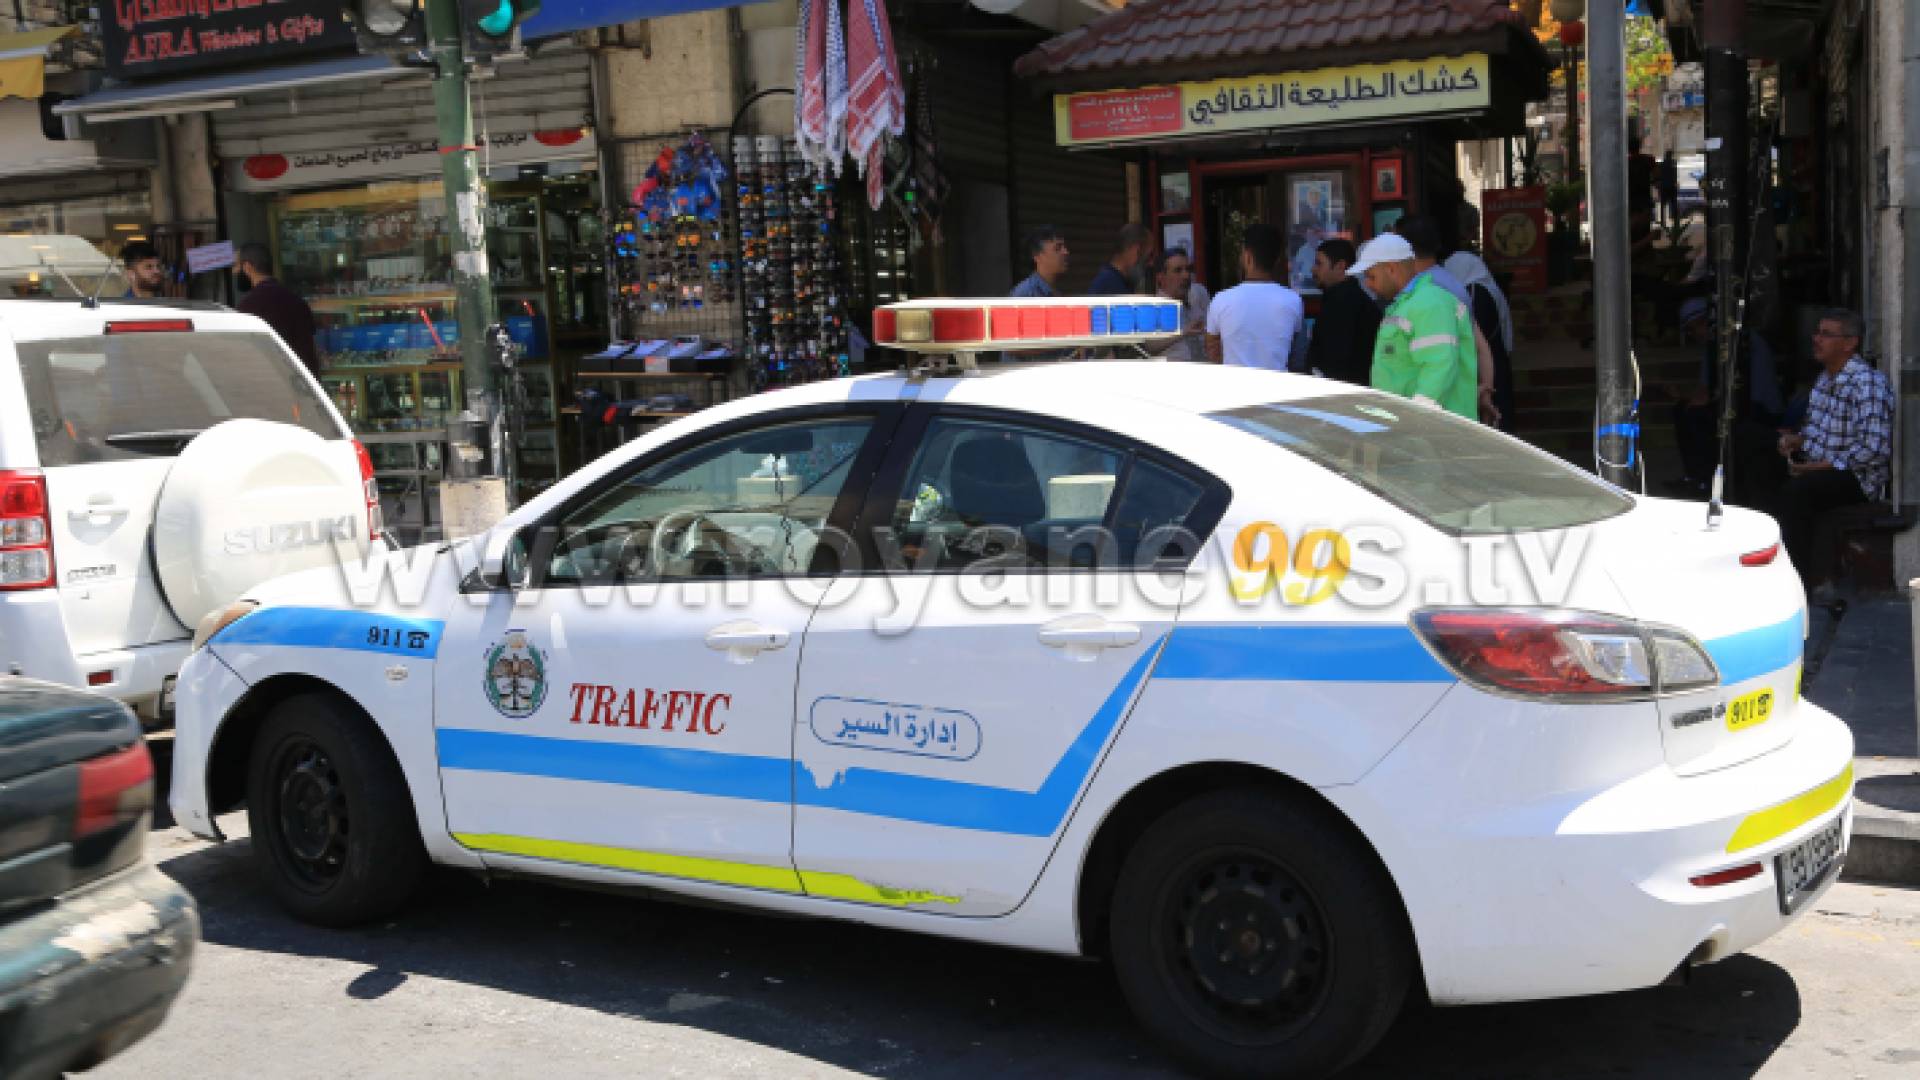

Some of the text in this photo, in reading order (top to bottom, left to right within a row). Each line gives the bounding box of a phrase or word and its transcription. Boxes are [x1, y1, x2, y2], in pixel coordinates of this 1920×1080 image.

[124, 27, 197, 64] AFRA
[1288, 71, 1396, 110] الطليعة
[1400, 64, 1480, 96] كشك
[1188, 82, 1285, 127] الثقافي
[223, 514, 358, 554] SUZUKI
[1231, 519, 1352, 605] 99
[366, 626, 402, 649] 911
[569, 682, 732, 736] TRAFFIC
[834, 709, 957, 751] إدارة السير
